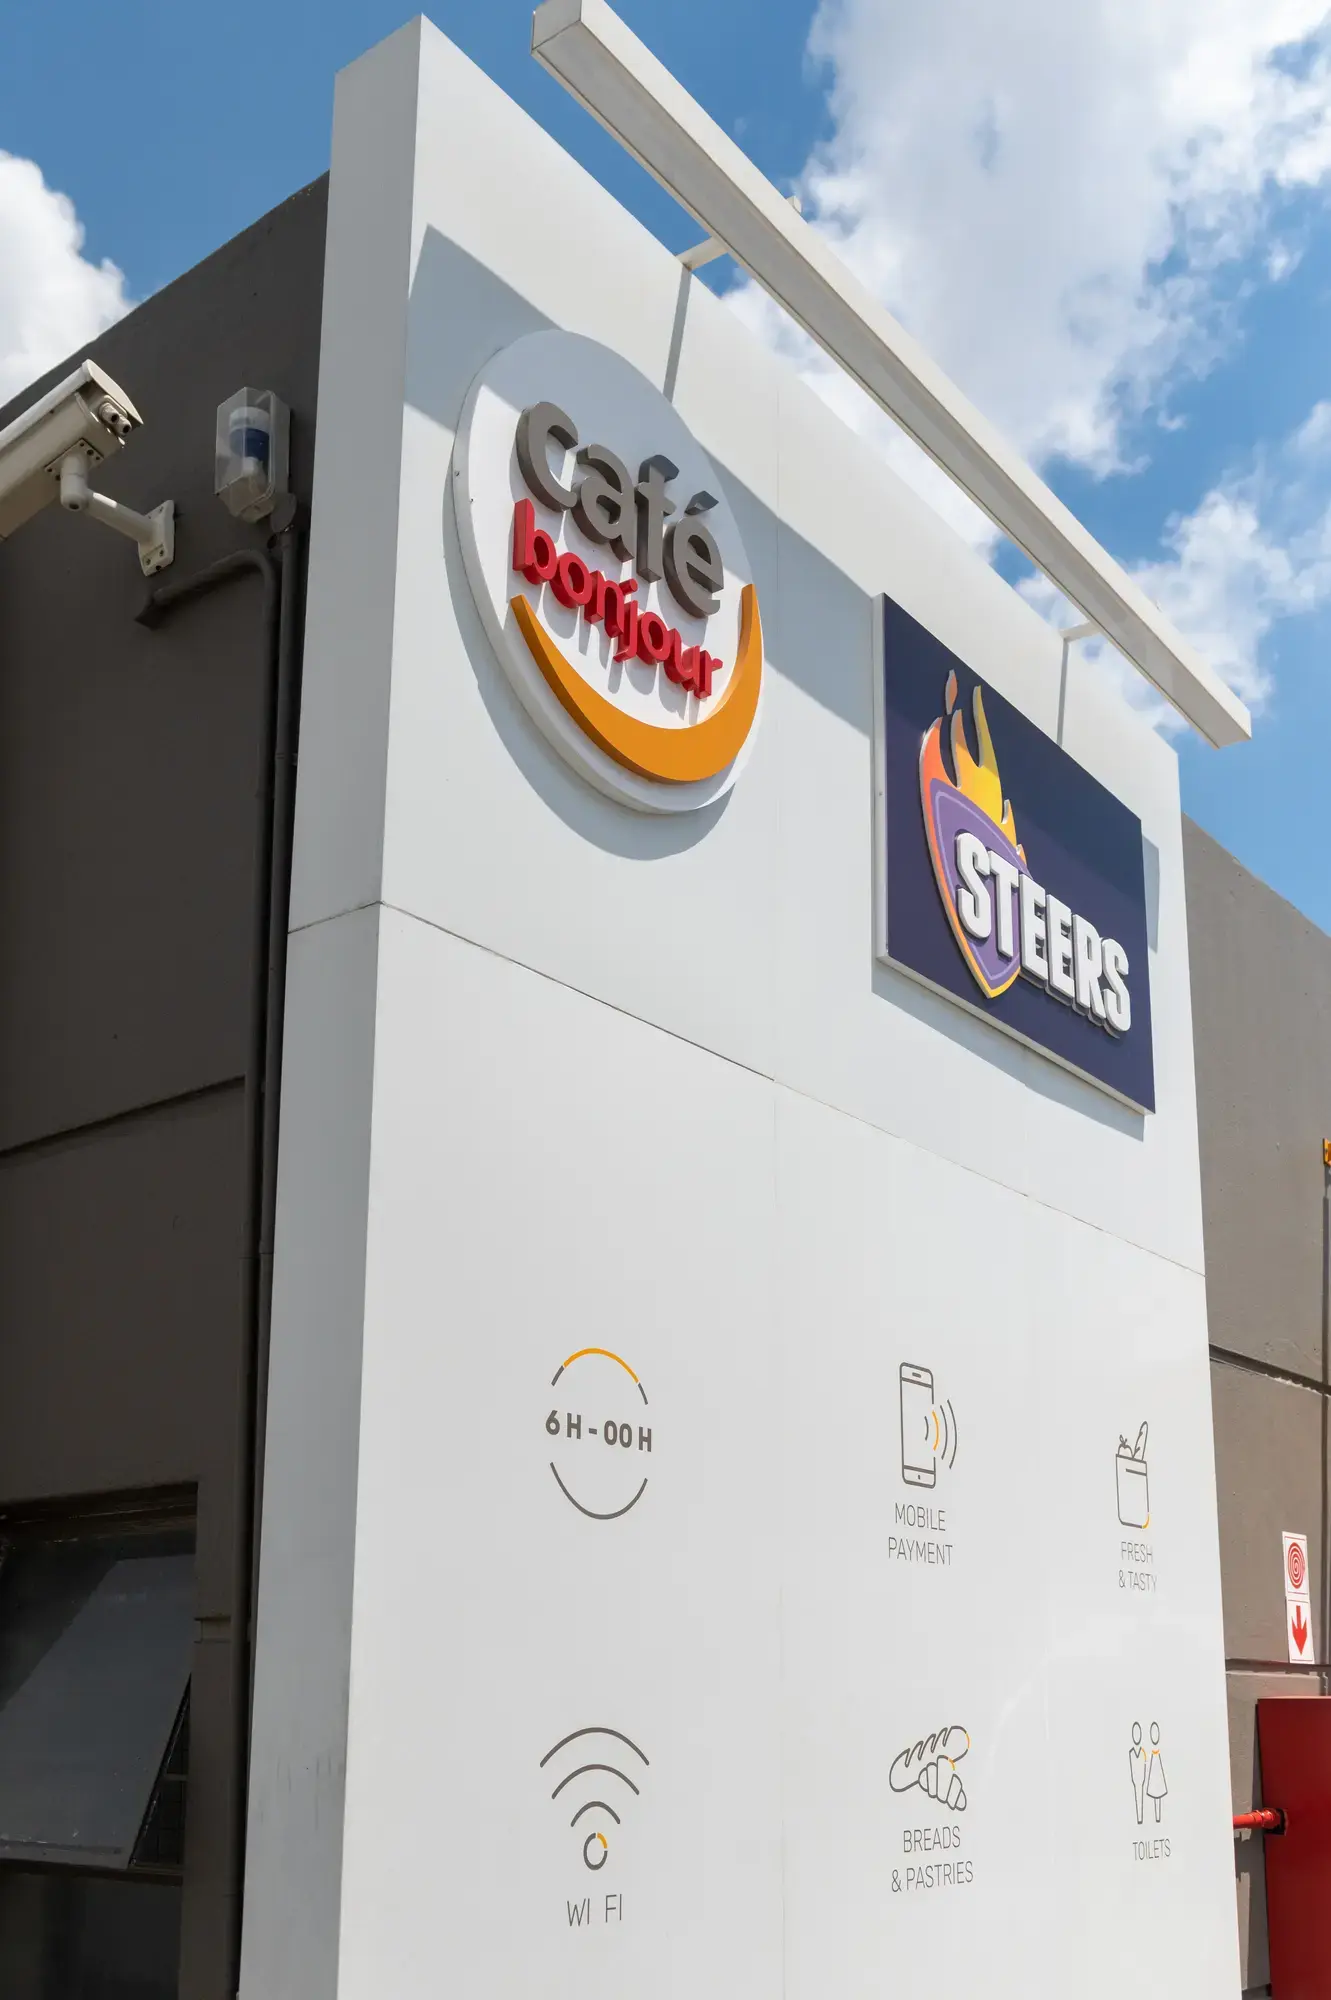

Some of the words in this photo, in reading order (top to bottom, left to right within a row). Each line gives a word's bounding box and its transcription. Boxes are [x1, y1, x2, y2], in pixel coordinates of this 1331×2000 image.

[515, 401, 724, 619] café
[512, 498, 723, 700] bonjour
[956, 832, 1132, 1034] STEERS
[895, 1502, 946, 1531] MOBILE
[888, 1536, 953, 1566] PAYMENT
[1121, 1541, 1153, 1565] FRESH
[1118, 1569, 1126, 1588] &
[1128, 1570, 1158, 1593] TASTY
[903, 1825, 961, 1853] BREADS
[1132, 1838, 1171, 1861] TOILETS
[891, 1869, 902, 1892] &
[906, 1860, 974, 1891] PASTRIES
